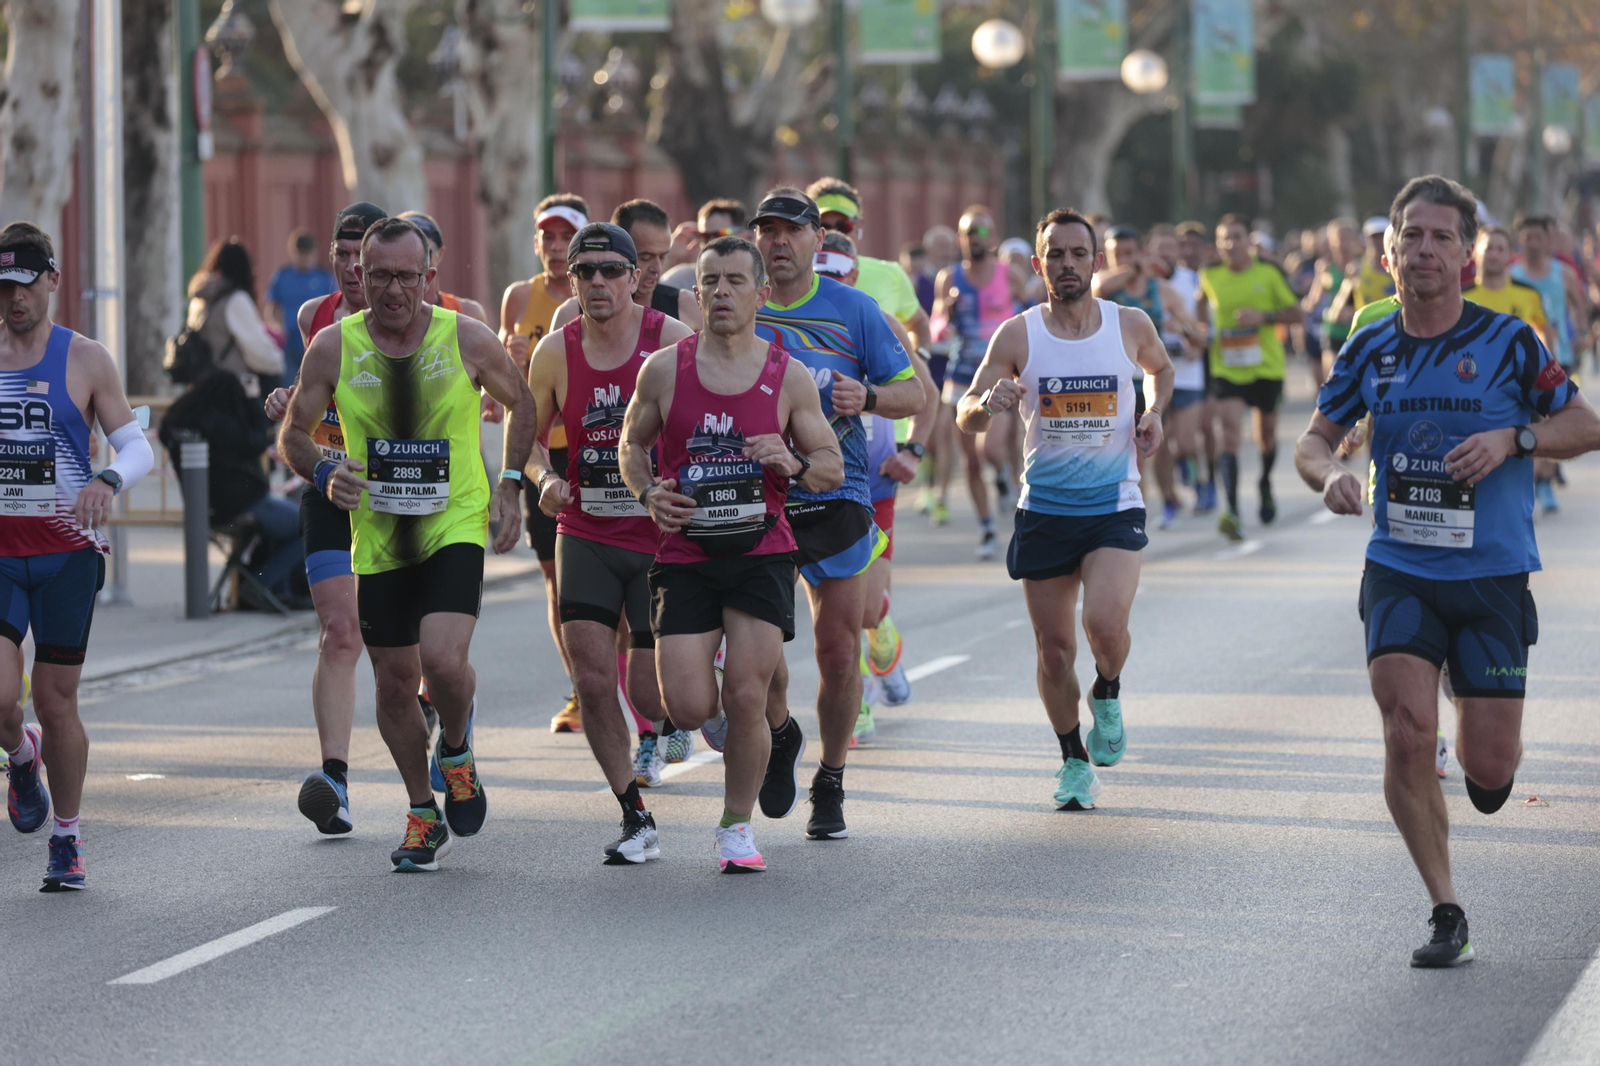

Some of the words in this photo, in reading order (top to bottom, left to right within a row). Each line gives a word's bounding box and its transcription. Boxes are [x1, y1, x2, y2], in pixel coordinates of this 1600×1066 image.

[1065, 379, 1109, 390] ZURICH
[1066, 402, 1091, 414] 5191
[1400, 397, 1483, 413] BESTIAJOS
[1049, 419, 1110, 430] LUCIAS-PAULA
[587, 430, 607, 442] LOS
[0, 445, 46, 456] ZURICH
[393, 443, 440, 454] ZURICH
[706, 464, 753, 477] ZURICH
[1411, 458, 1463, 474] ZURI
[0, 467, 26, 480] 2241
[392, 466, 423, 480] 2893
[3, 487, 24, 498] JAVI
[379, 484, 403, 496] JUAN
[405, 485, 437, 497] PALMA
[708, 489, 738, 503] 1860
[1409, 486, 1442, 503] 2103
[708, 508, 739, 519] MARIO
[1404, 509, 1446, 523] MANUEL
